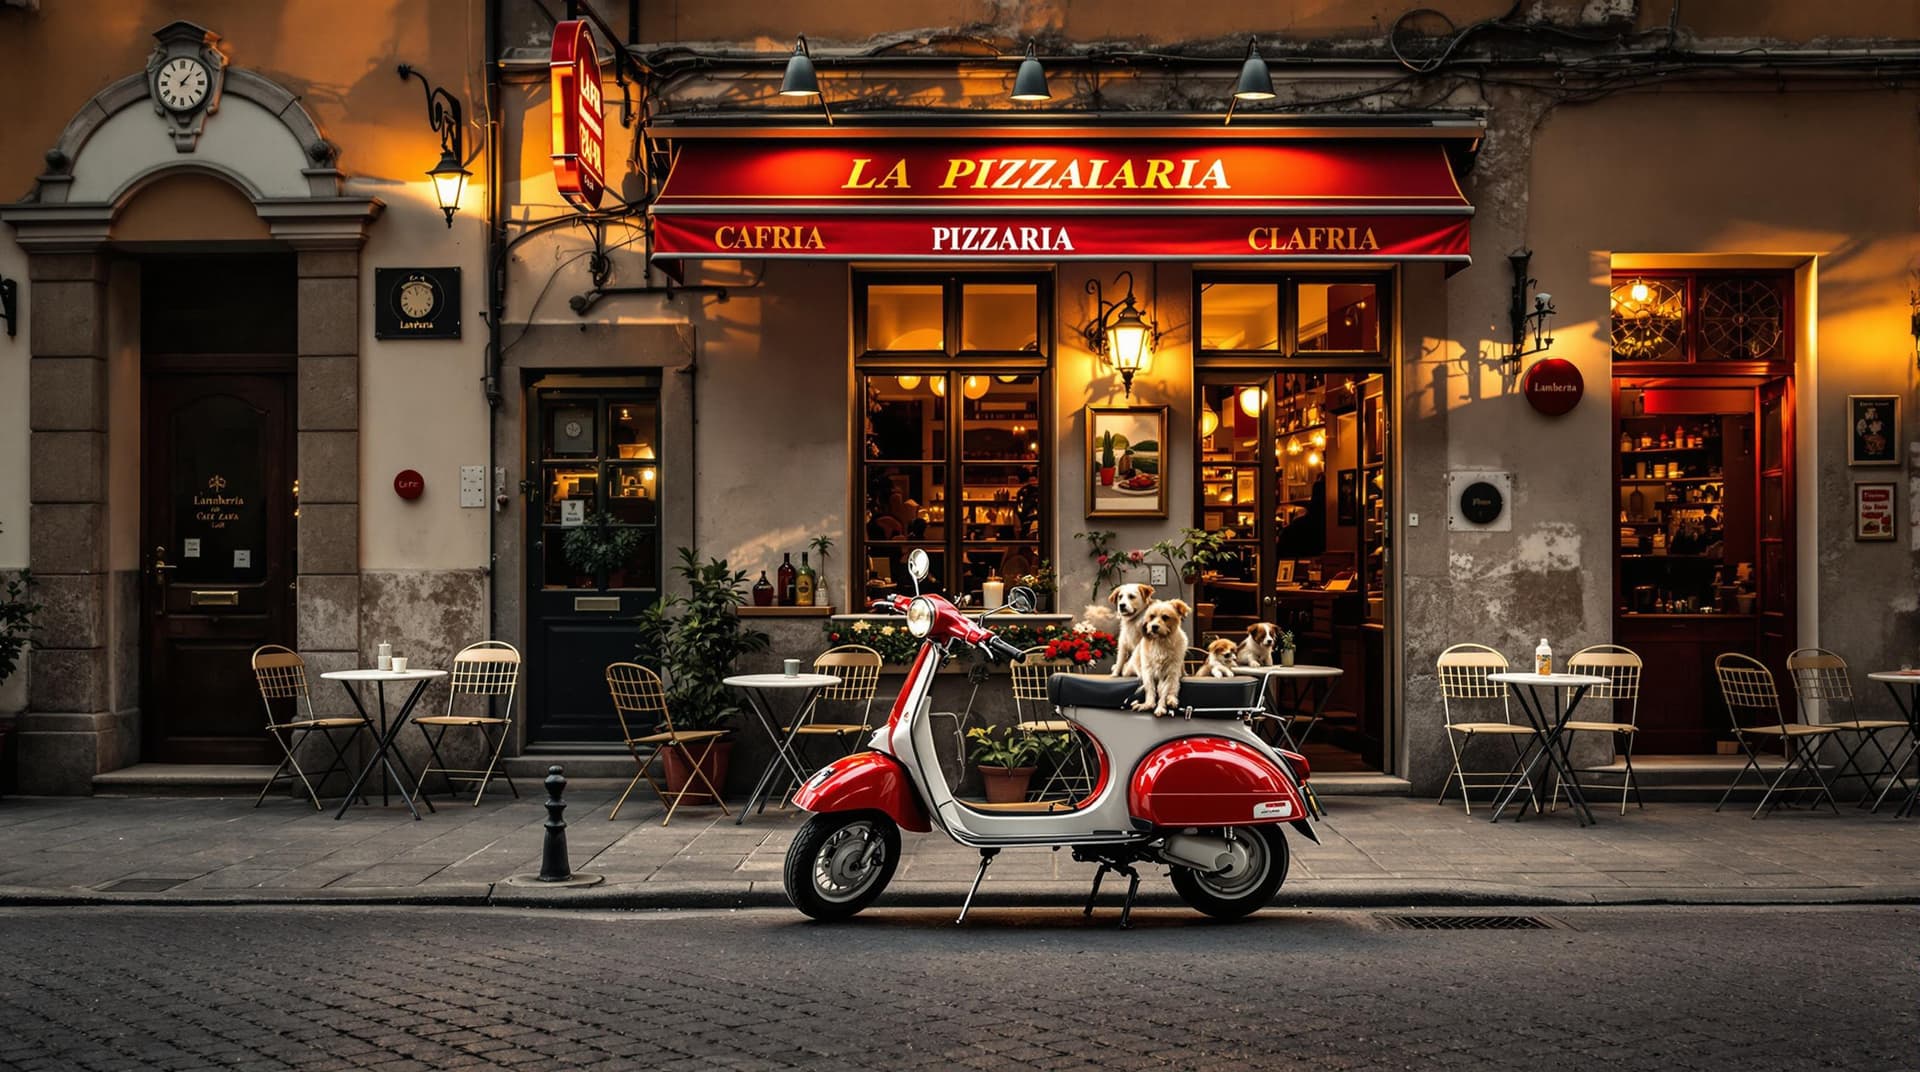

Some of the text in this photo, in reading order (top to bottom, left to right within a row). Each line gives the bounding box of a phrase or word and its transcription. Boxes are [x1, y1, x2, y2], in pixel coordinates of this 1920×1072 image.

[841, 158, 911, 190] LA
[715, 225, 827, 250] CAFRIA
[932, 225, 1076, 251] PIZZARIA
[1248, 226, 1381, 251] CLAFRIA
